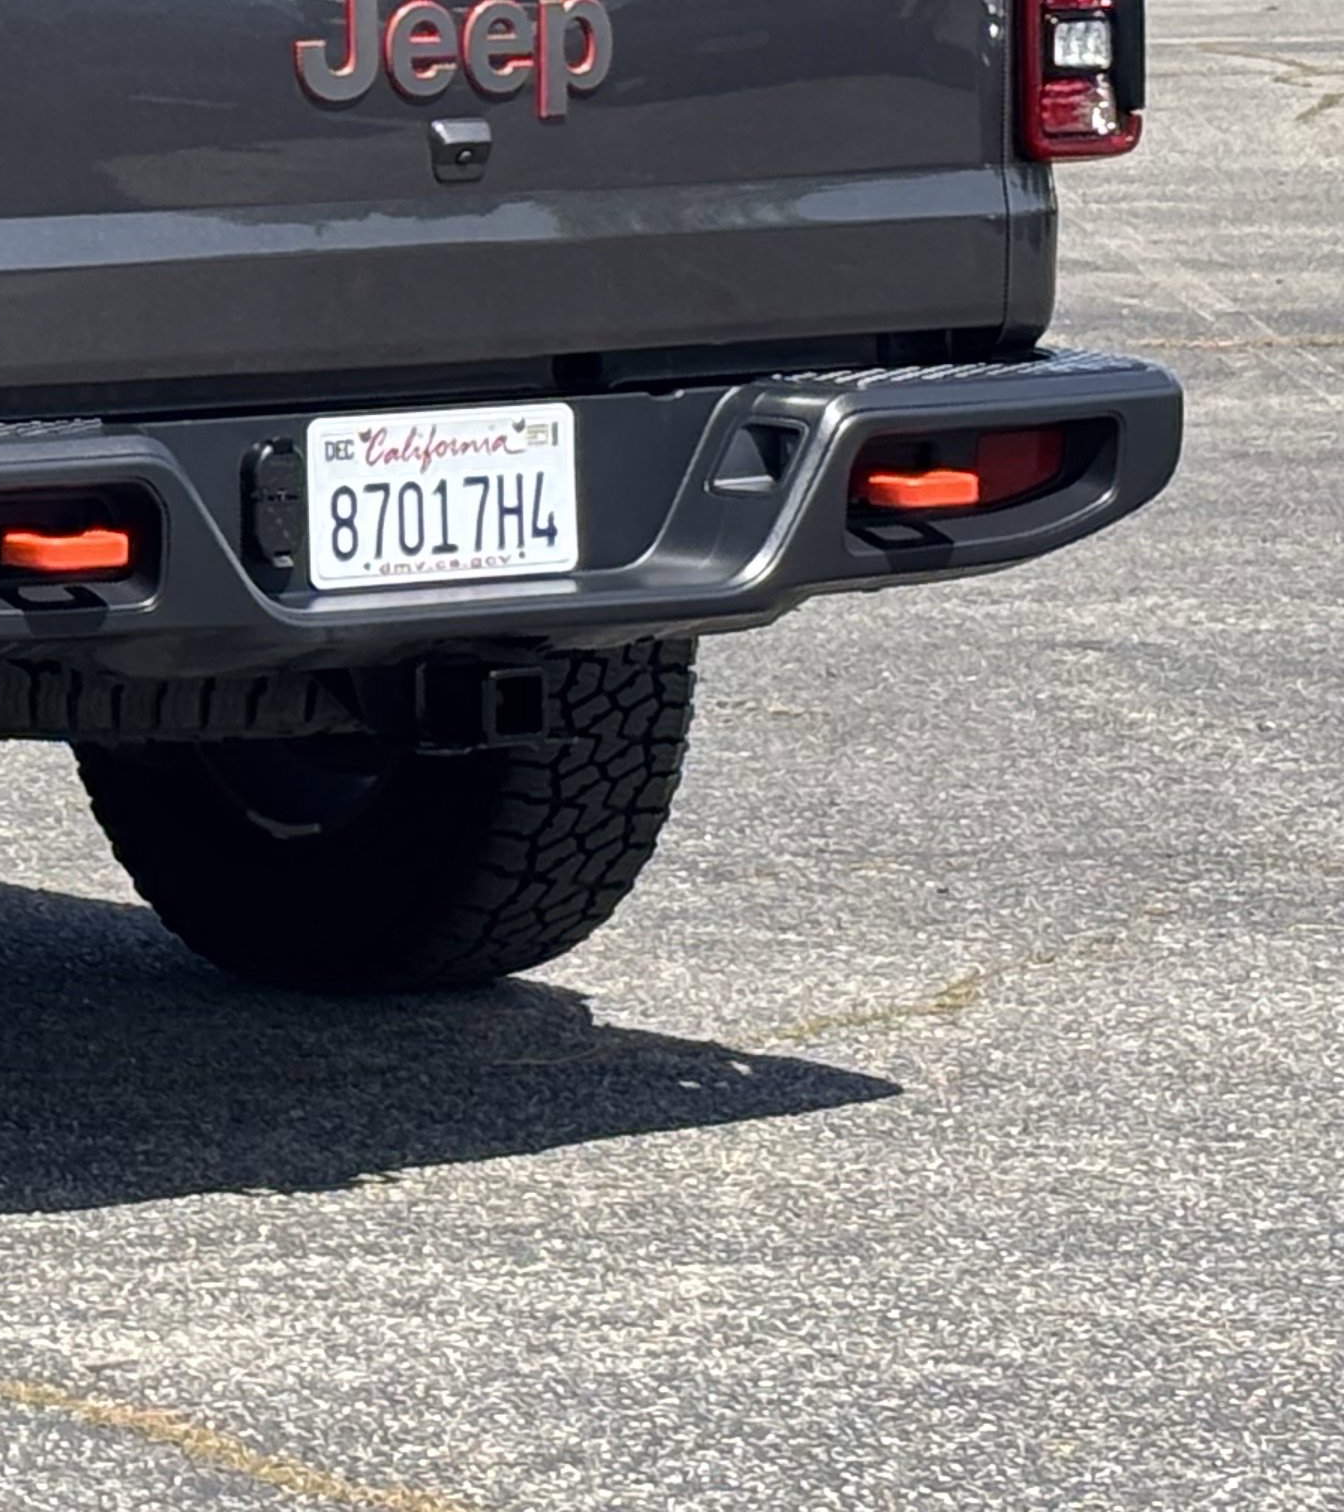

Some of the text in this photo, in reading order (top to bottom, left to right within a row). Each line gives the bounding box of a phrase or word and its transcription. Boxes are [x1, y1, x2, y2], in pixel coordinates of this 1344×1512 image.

[324, 439, 355, 461] DEC
[365, 424, 527, 473] California
[330, 471, 558, 562] 87017H4
[379, 554, 511, 575] dmv.ca.gov
